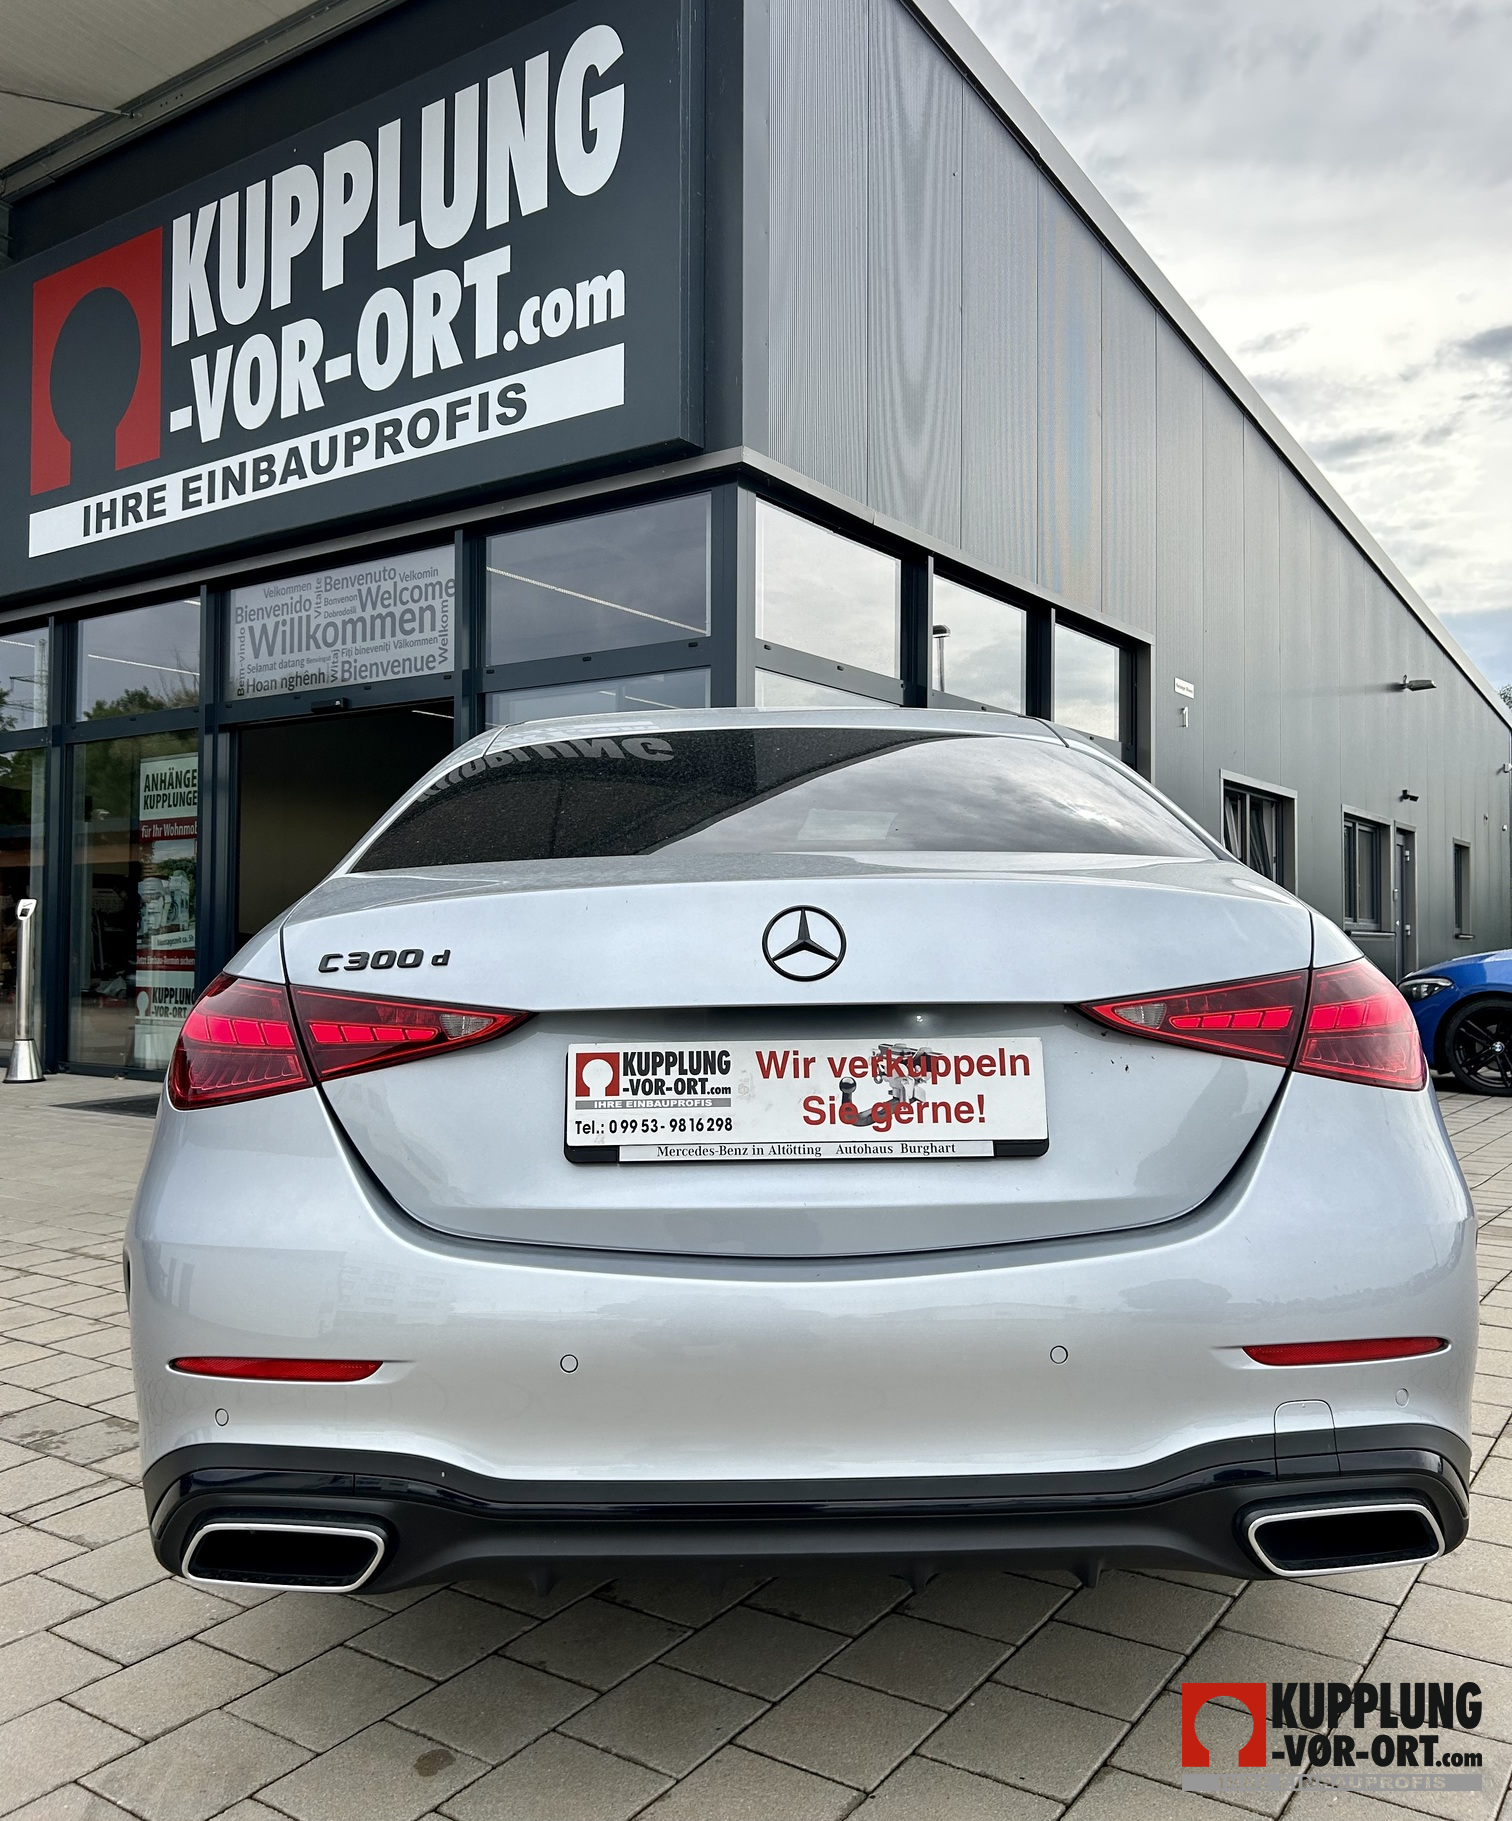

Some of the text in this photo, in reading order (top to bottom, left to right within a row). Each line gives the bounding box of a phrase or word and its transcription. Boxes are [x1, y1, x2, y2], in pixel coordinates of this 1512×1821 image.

[171, 24, 625, 346] KUPPLUNG
[170, 245, 625, 443] -VOR-ORT.com
[83, 382, 527, 537] IHRE EINBAUPROFIS
[324, 566, 397, 593] Benvenuto
[399, 566, 439, 583] Velkomin
[263, 582, 312, 599] Velkommen
[357, 578, 455, 613] Welcome
[235, 594, 312, 624] Bienvenido
[248, 604, 436, 659] Willkommen
[393, 636, 438, 650] Välkommen
[438, 599, 448, 664] Welkom
[237, 627, 245, 697] Bem-vindo
[247, 658, 305, 674] Selamat datang
[331, 649, 340, 683] Witaj
[341, 654, 437, 682] Bienvenue
[246, 678, 277, 694] Hoan
[280, 668, 325, 691] nghênh
[144, 767, 197, 793] ANHÄNGE
[143, 790, 197, 810] KUPPLUNGE
[141, 824, 152, 838] für
[152, 824, 163, 838] Ihr
[318, 949, 450, 973] C300 d
[623, 1050, 731, 1076] KUPPLUNG
[756, 1048, 1030, 1084] Wir verkuppeln
[623, 1078, 731, 1095] -VOR-ORT.com
[594, 1099, 712, 1109] IHRE EINBAUPROFIS
[803, 1094, 986, 1132] Sie gerne!
[575, 1120, 604, 1134] Tel.:
[657, 1143, 956, 1157] Mercedes-Benz in Altötting Autohaus Burghart
